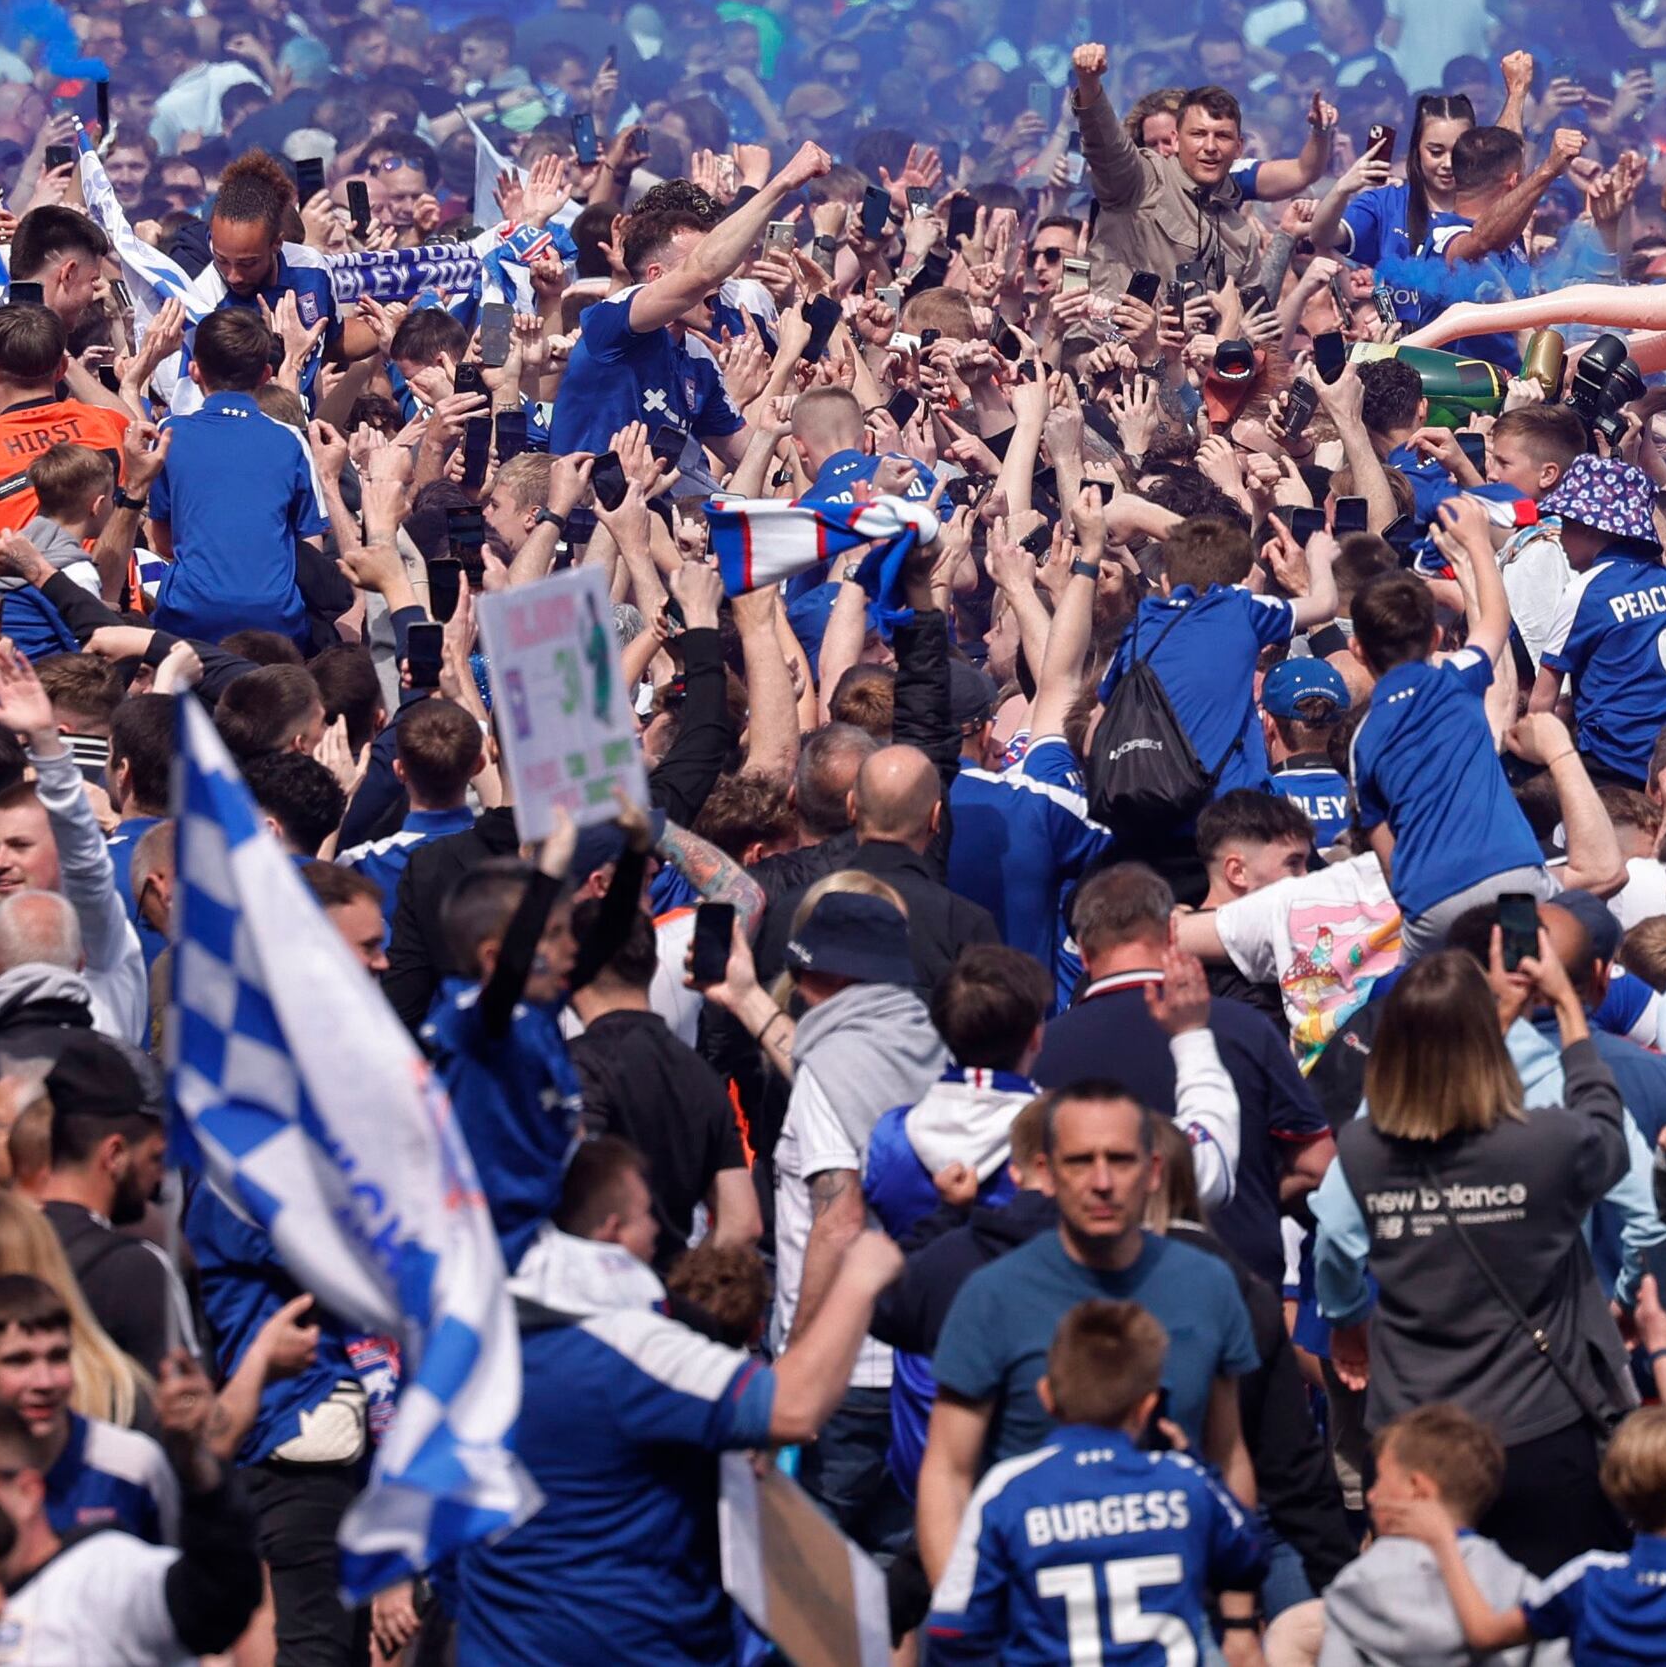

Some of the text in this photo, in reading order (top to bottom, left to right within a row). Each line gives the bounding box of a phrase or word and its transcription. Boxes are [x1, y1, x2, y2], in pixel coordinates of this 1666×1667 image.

[326, 246, 401, 269] WICH
[333, 260, 480, 300] BLEY 200
[4, 419, 83, 458] HIRST
[1365, 1189, 1417, 1214] new
[1024, 1489, 1191, 1549] BURGESS
[1035, 1552, 1199, 1667] 15
